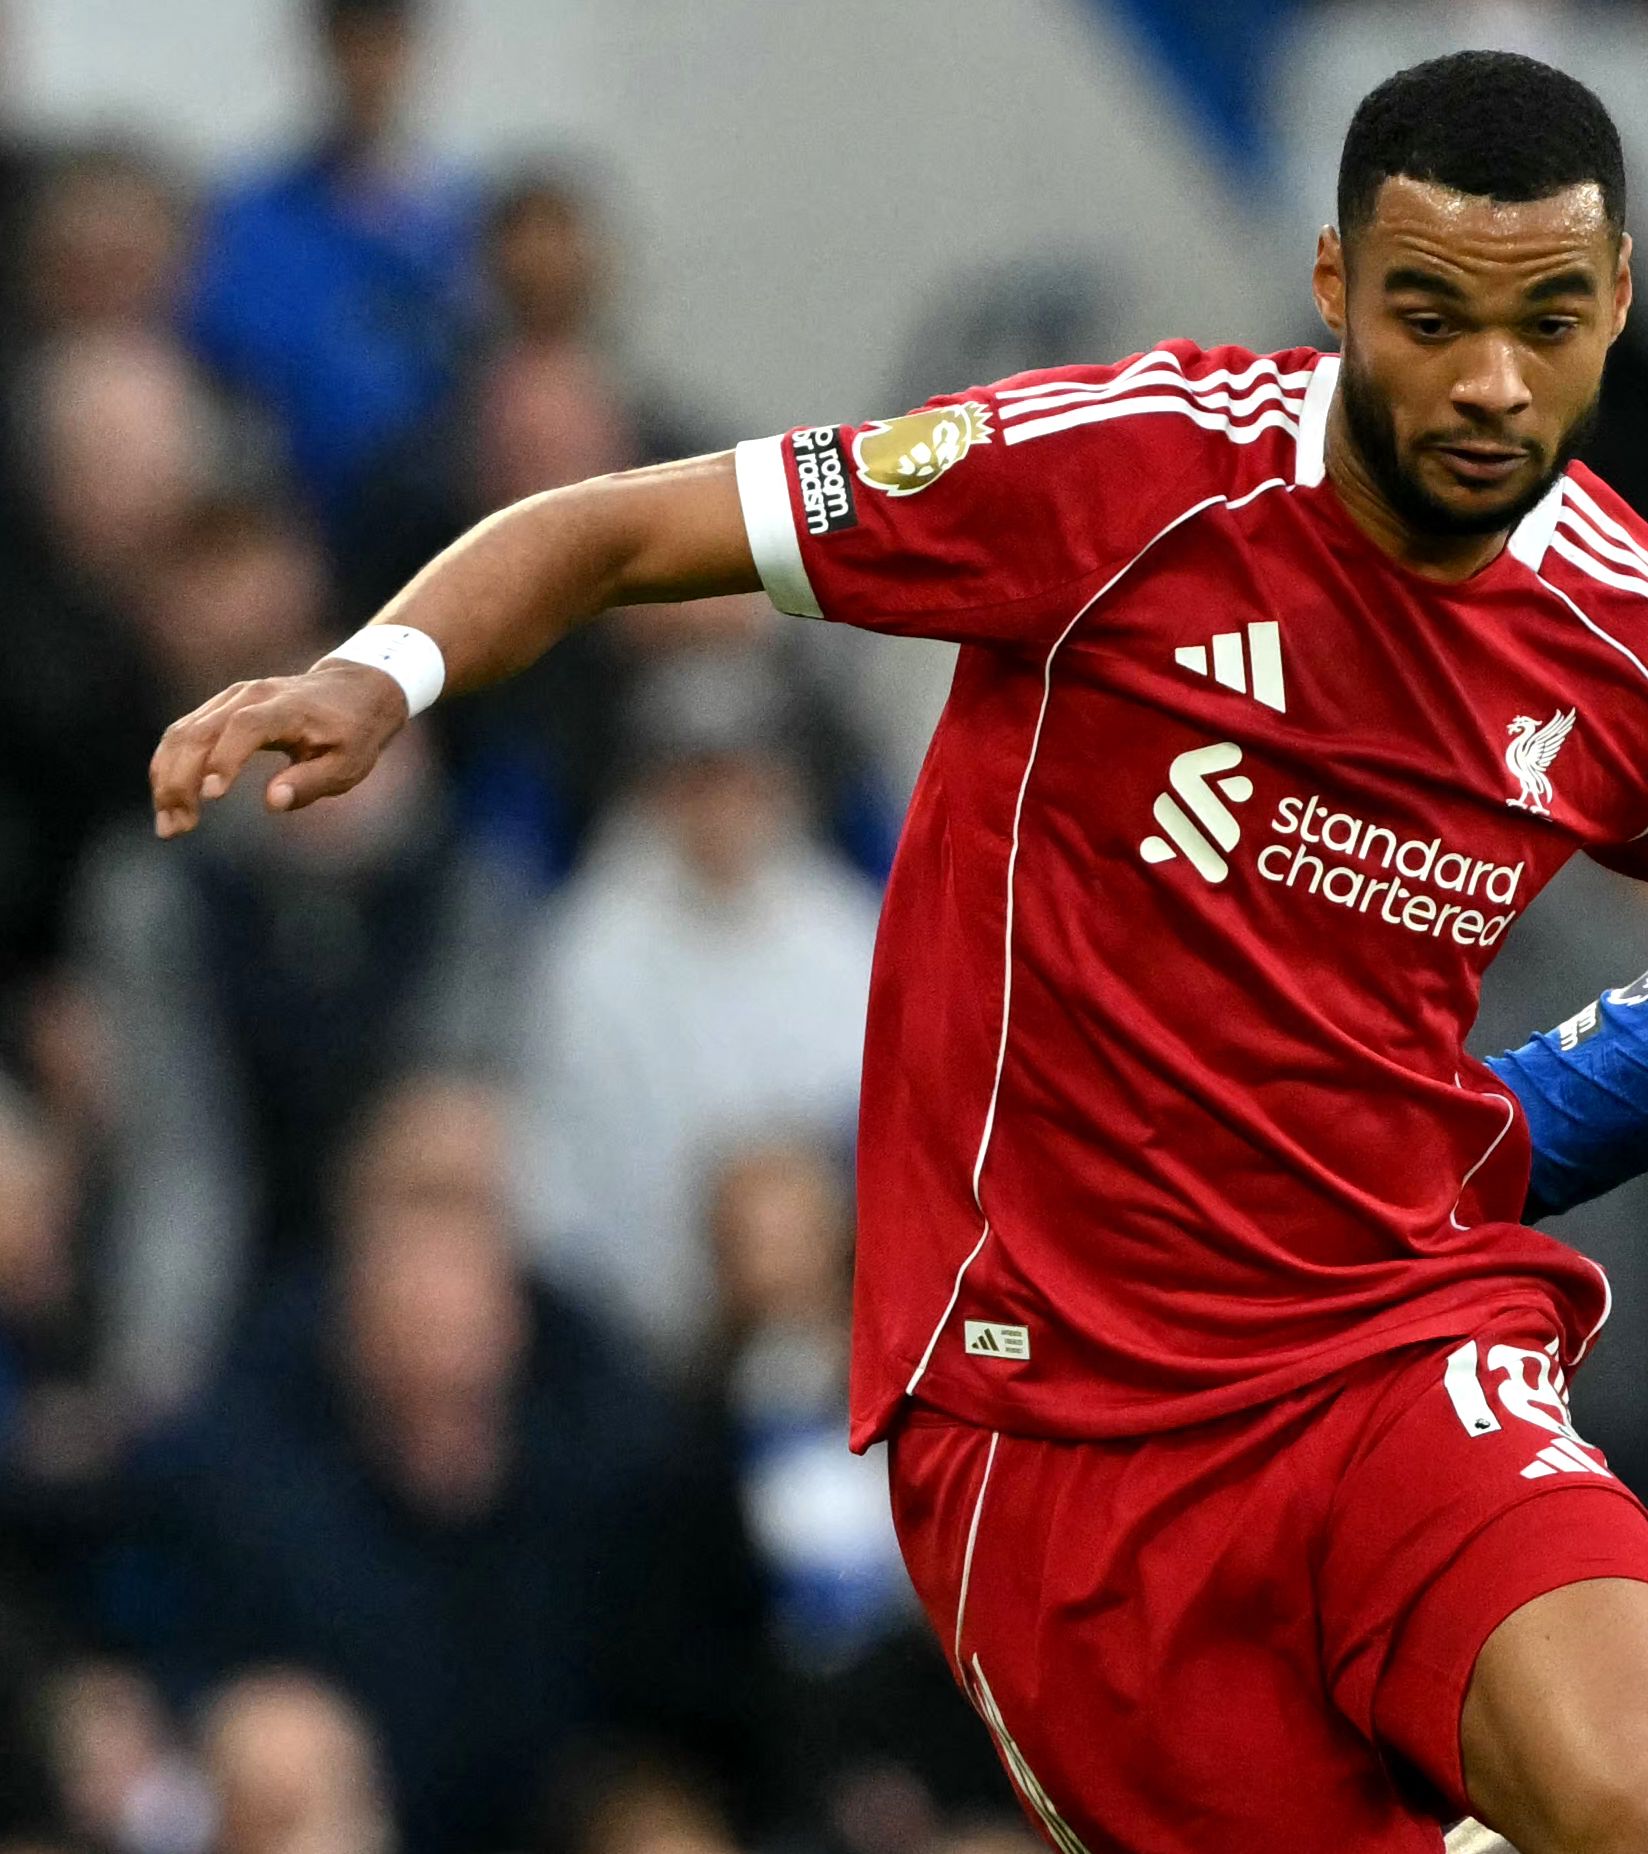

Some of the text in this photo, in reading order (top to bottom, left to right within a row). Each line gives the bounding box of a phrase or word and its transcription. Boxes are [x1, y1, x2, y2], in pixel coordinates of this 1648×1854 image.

[796, 452, 829, 535] racism
[812, 426, 849, 518] o room
[1257, 844, 1517, 947] chartered
[1271, 795, 1525, 905] standard
